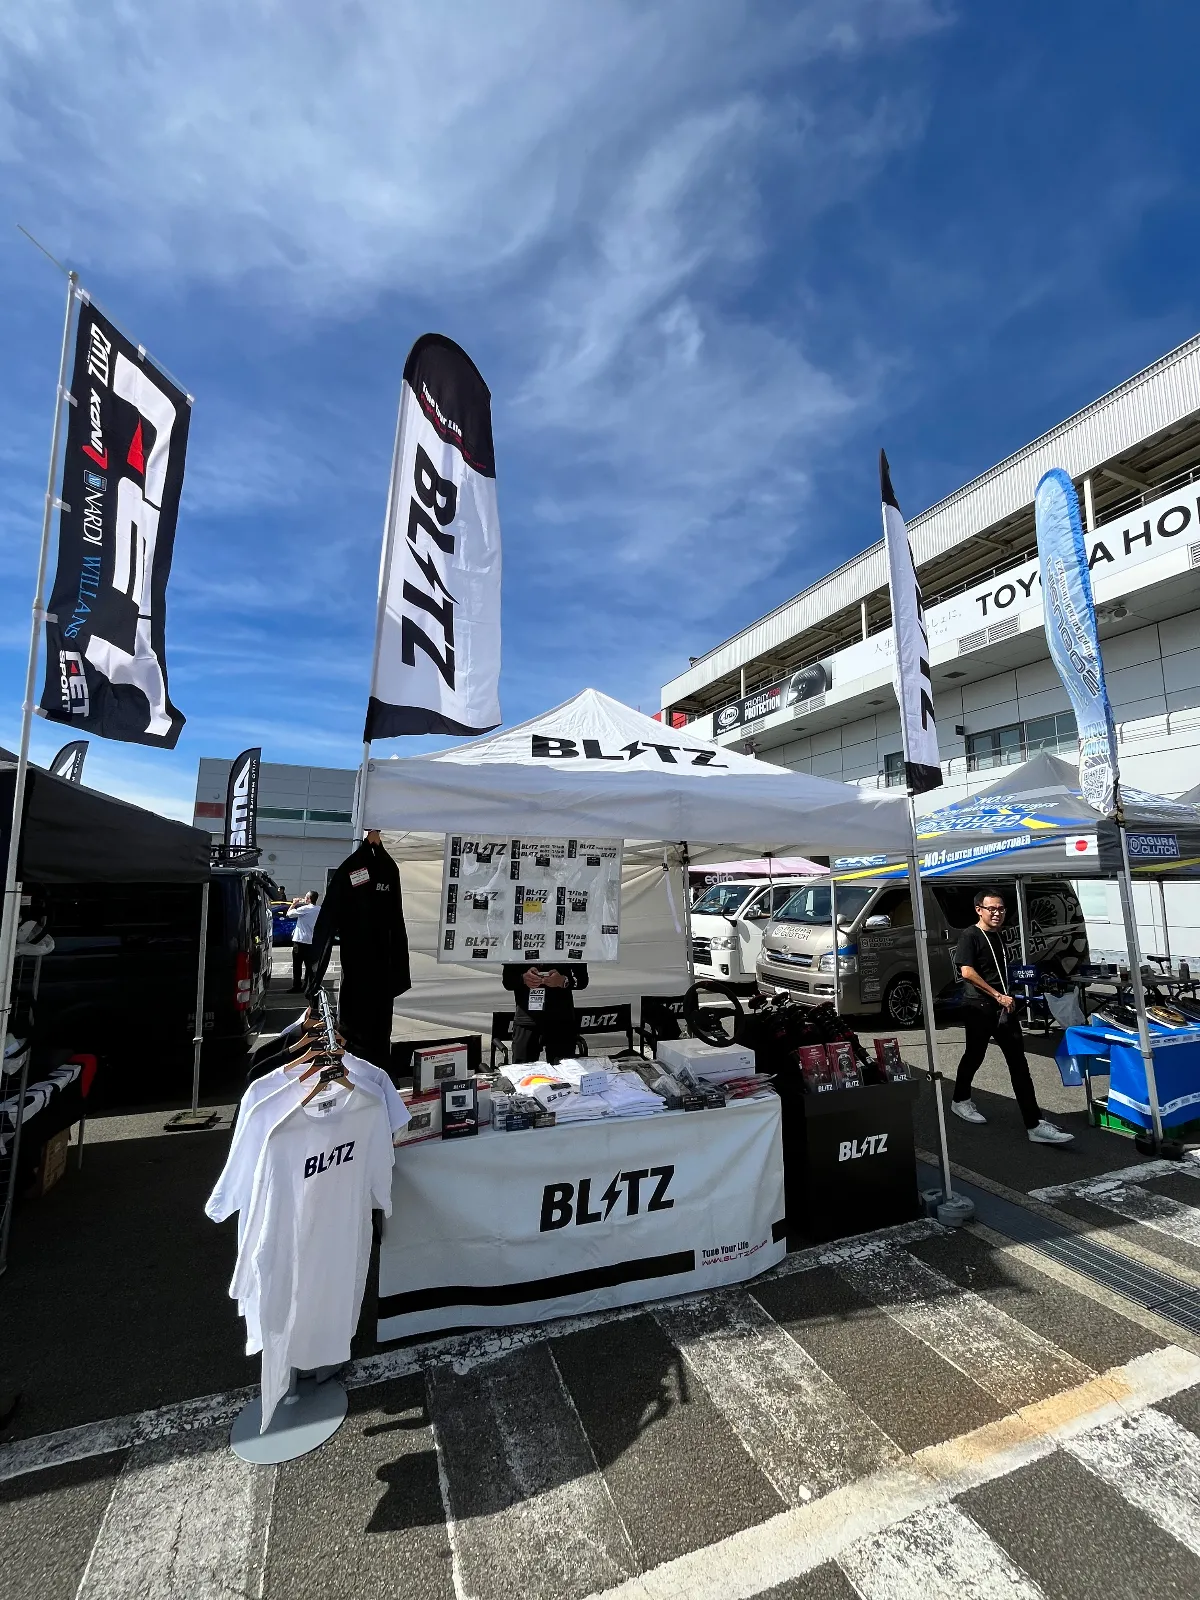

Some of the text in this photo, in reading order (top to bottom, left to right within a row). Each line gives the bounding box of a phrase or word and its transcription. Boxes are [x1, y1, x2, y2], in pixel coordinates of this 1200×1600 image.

[82, 485, 104, 547] NARDI
[401, 443, 460, 692] BLITZ
[975, 496, 1200, 616] TOYA HO
[64, 555, 102, 640] WILLANS
[59, 649, 72, 712] SPORT
[744, 687, 781, 707] PRIORITY FOR
[744, 694, 781, 721] PROTECTION
[531, 734, 729, 768] BLITZ
[462, 842, 507, 855] BLITZ
[947, 846, 972, 863] CLUTCH
[973, 834, 1031, 857] MANUFACTURER
[1139, 836, 1175, 846] OGURA
[1141, 845, 1177, 855] CLUTCH
[526, 889, 547, 897] BLITZ
[523, 941, 545, 949] BLITZ
[524, 933, 545, 941] BLITZ
[580, 1013, 618, 1028] BLITZ
[818, 1084, 833, 1092] BLITZ
[845, 1080, 859, 1088] BLITZ
[839, 1133, 888, 1161] BLITZ
[304, 1140, 355, 1179] BLITZ
[539, 1164, 675, 1232] BLITZ
[702, 1240, 749, 1258] Tune Your Life
